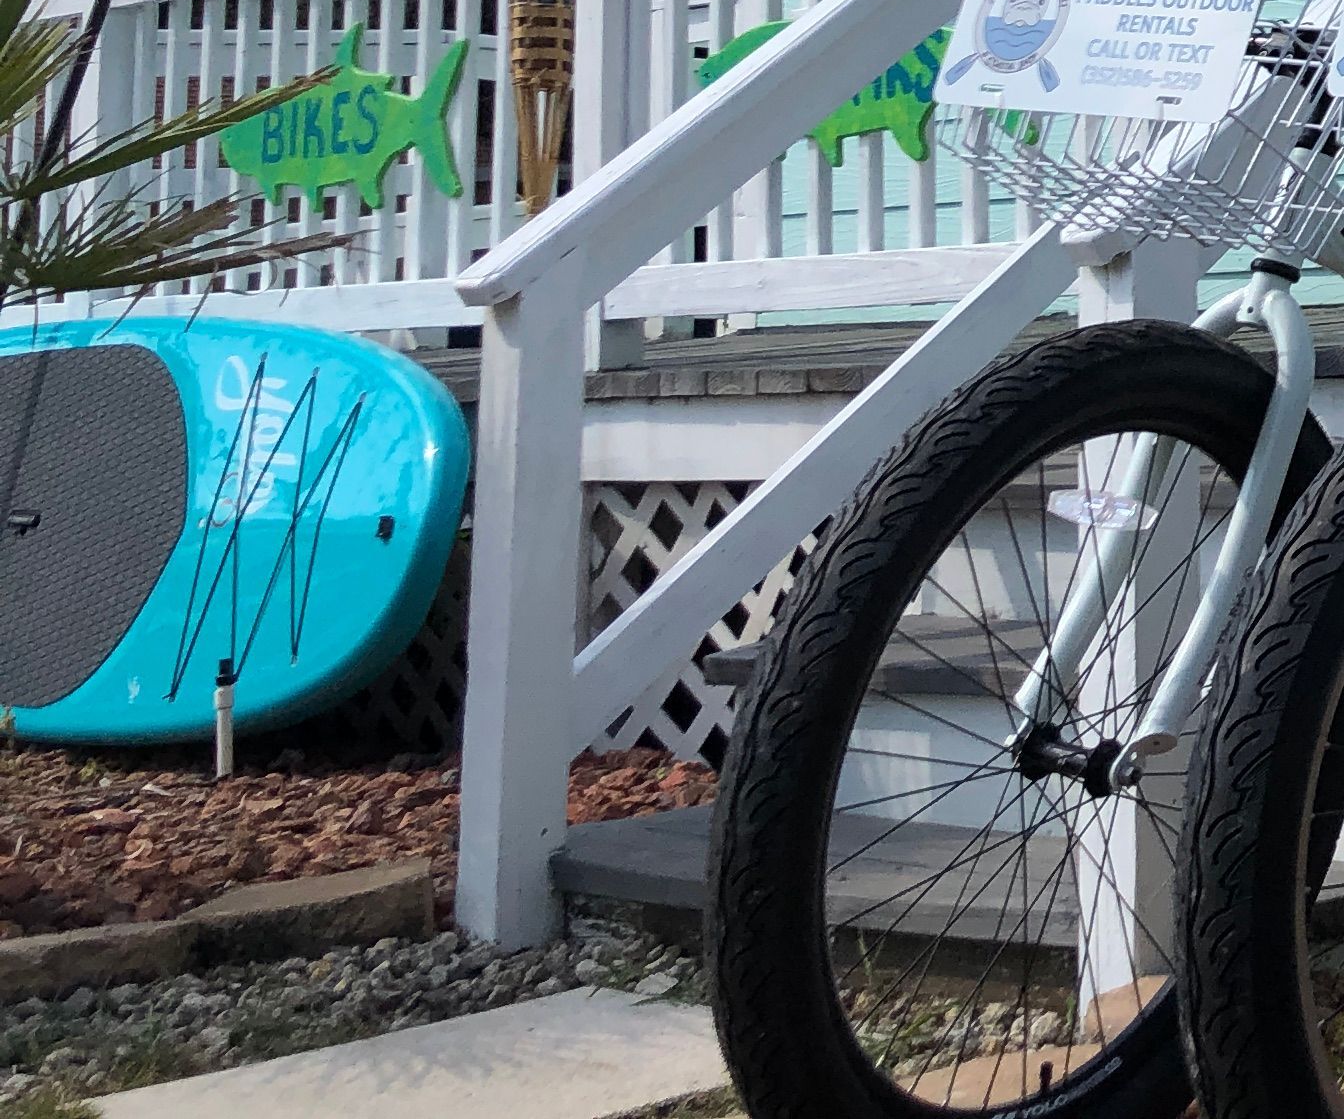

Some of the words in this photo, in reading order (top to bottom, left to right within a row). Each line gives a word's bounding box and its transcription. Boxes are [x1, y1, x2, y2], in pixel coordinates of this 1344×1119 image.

[1116, 14, 1198, 36] RENTALS
[1086, 38, 1129, 59] CALL
[1135, 42, 1163, 61] OR
[1167, 43, 1216, 64] TEXT
[261, 84, 378, 164] BIKES
